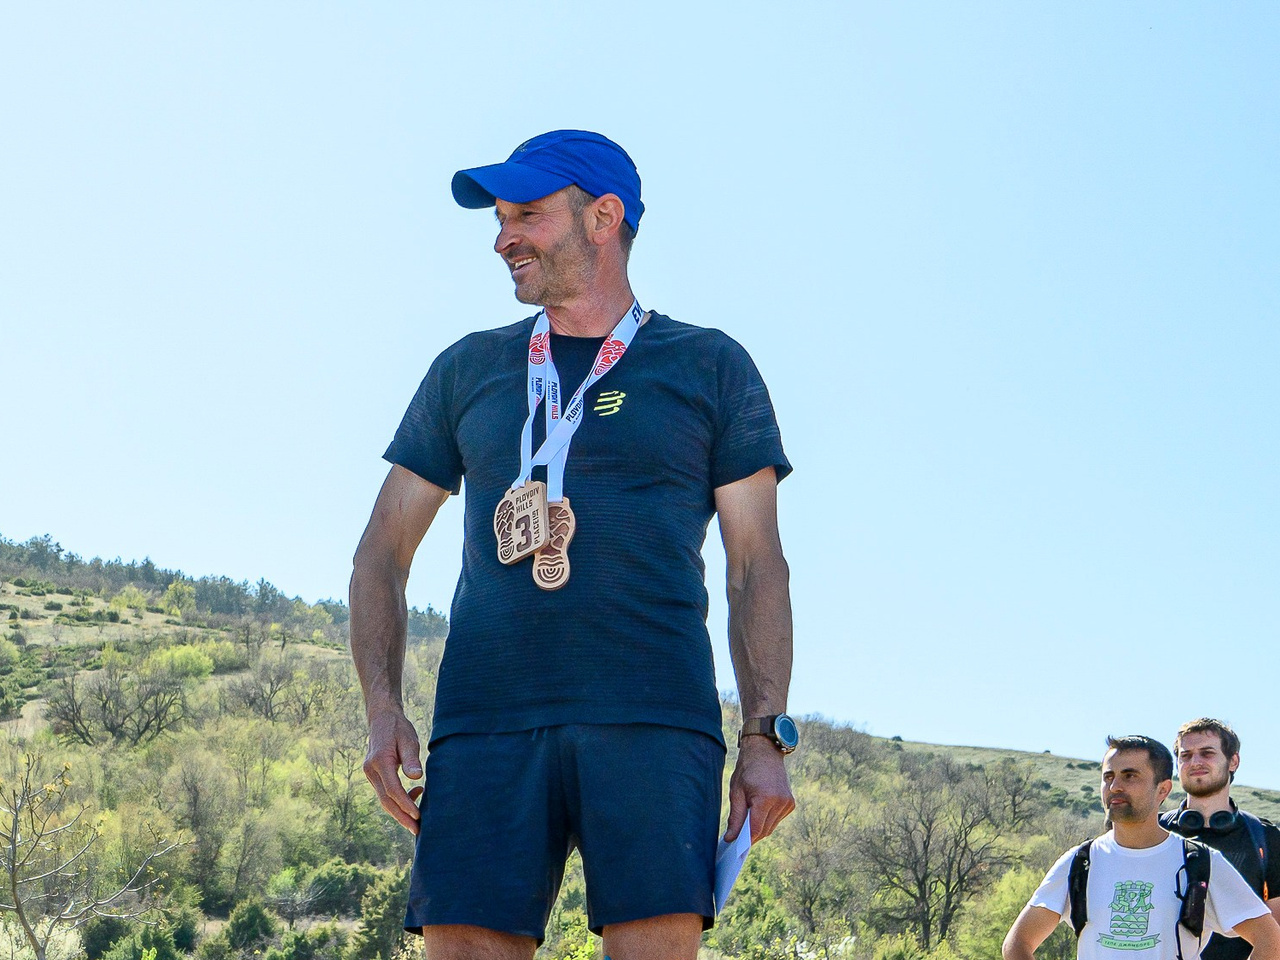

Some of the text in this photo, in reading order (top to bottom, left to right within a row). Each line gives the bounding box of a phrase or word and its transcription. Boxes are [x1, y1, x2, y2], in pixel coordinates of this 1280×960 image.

[515, 486, 540, 505] PLOVDIV
[516, 500, 533, 514] HILLS
[515, 514, 532, 553] 3
